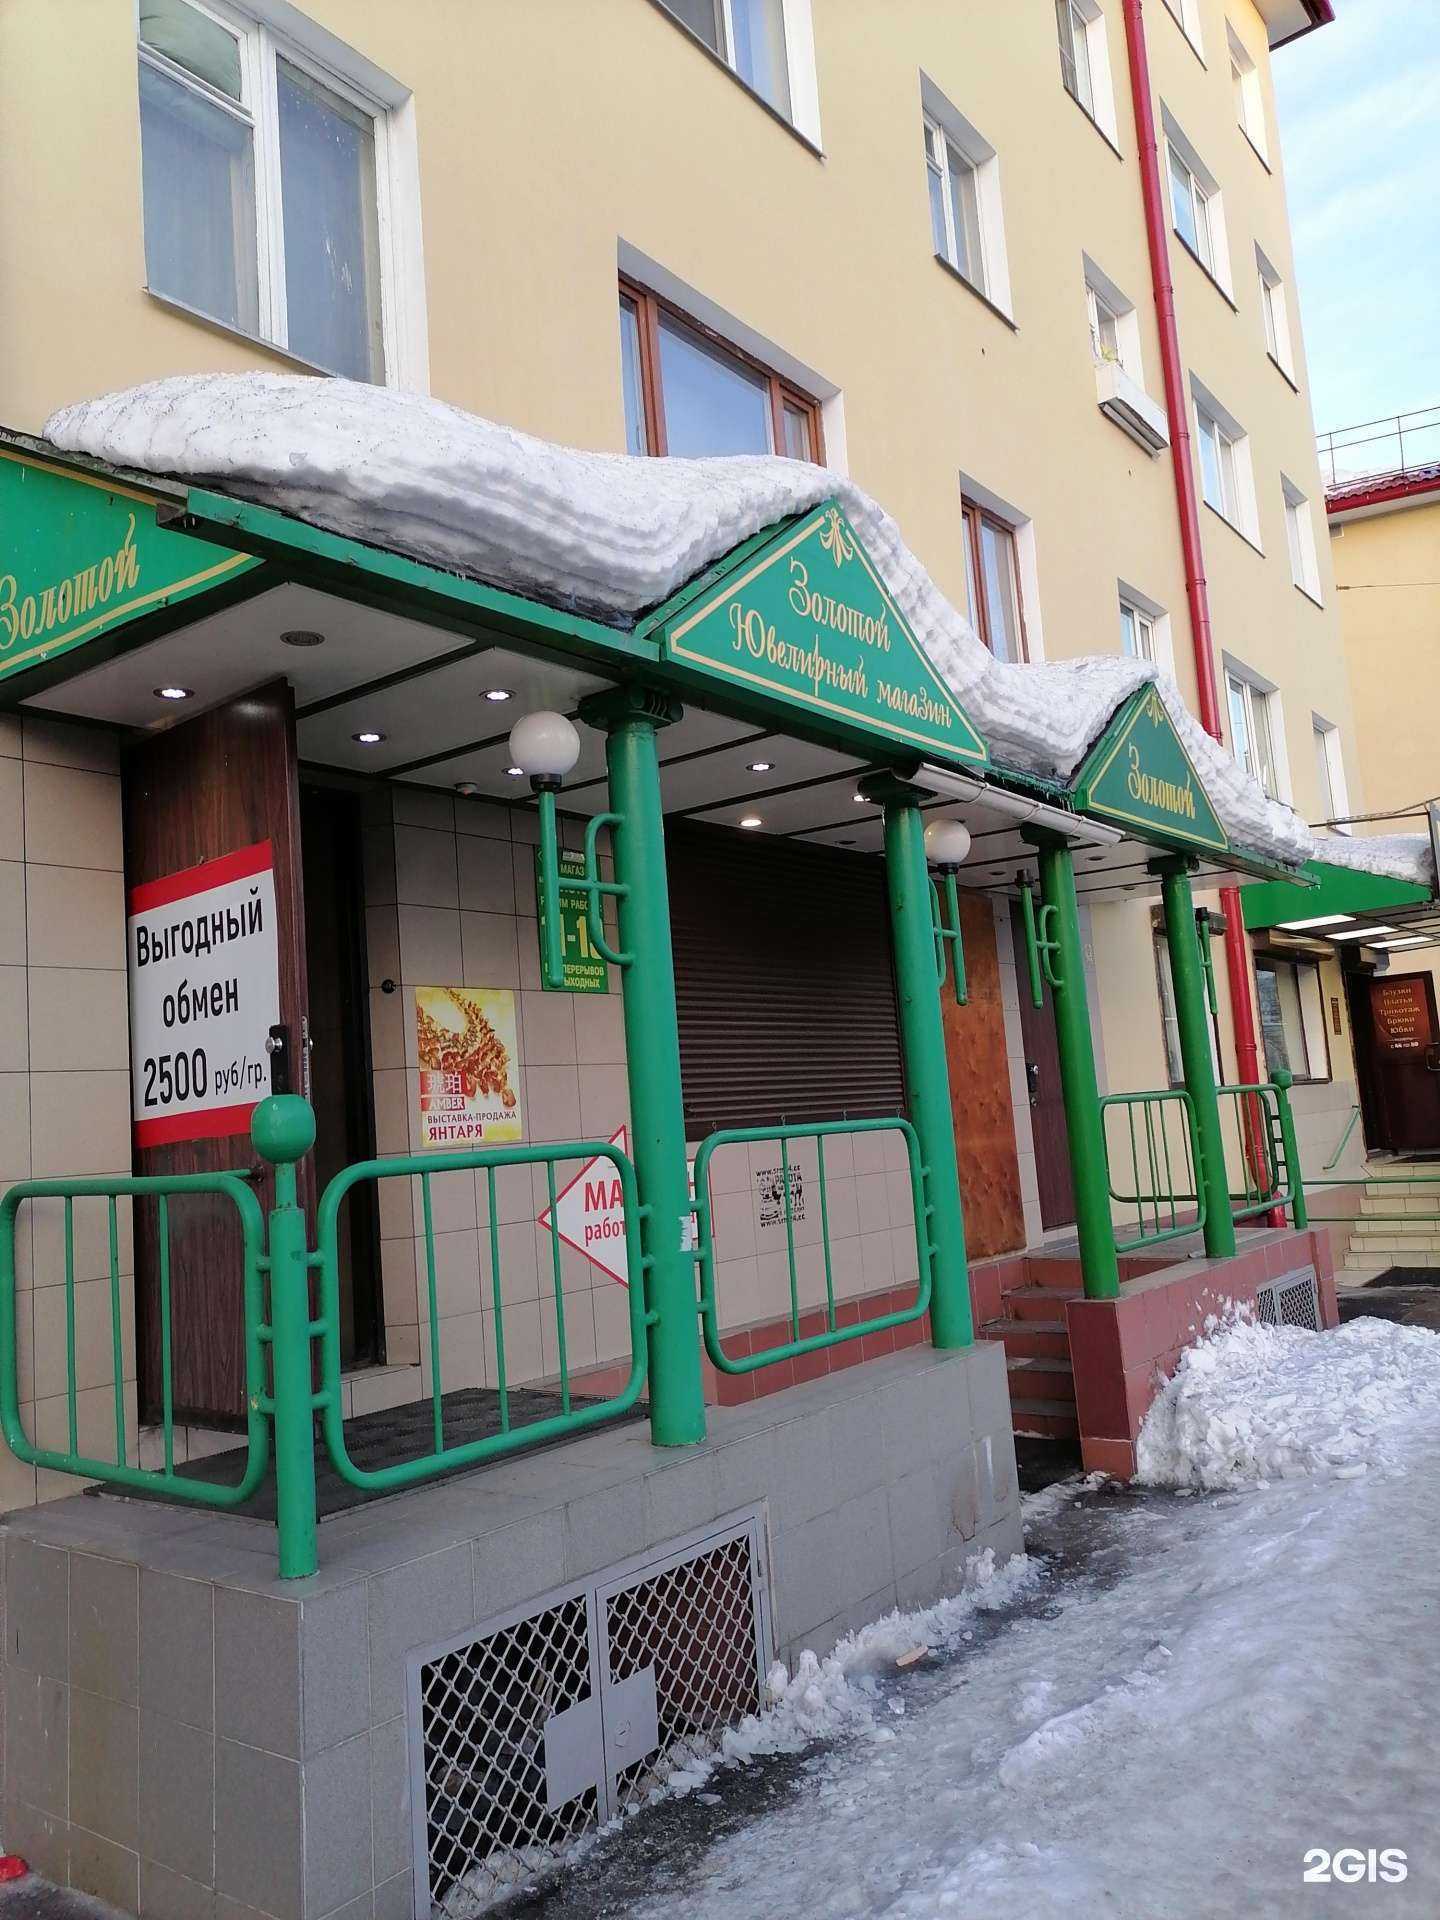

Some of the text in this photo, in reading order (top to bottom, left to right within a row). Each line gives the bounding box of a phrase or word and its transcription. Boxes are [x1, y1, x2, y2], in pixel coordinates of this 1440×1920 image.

[0, 512, 141, 648] Золотой
[789, 556, 891, 652] Золотой
[729, 602, 953, 728] Ювелирный магазин
[1128, 742, 1196, 820] Золотой
[136, 886, 263, 967] Выгодный
[162, 978, 239, 1028] обмен
[563, 976, 601, 990] ЫХОДНЫХ
[143, 1047, 267, 1107] 2500 руб/гр.
[430, 1097, 465, 1110] AMBER
[427, 1111, 517, 1124] ВЫСТАВКА-ПРОДАЖА
[429, 1124, 484, 1141] ЯНТАРЯ
